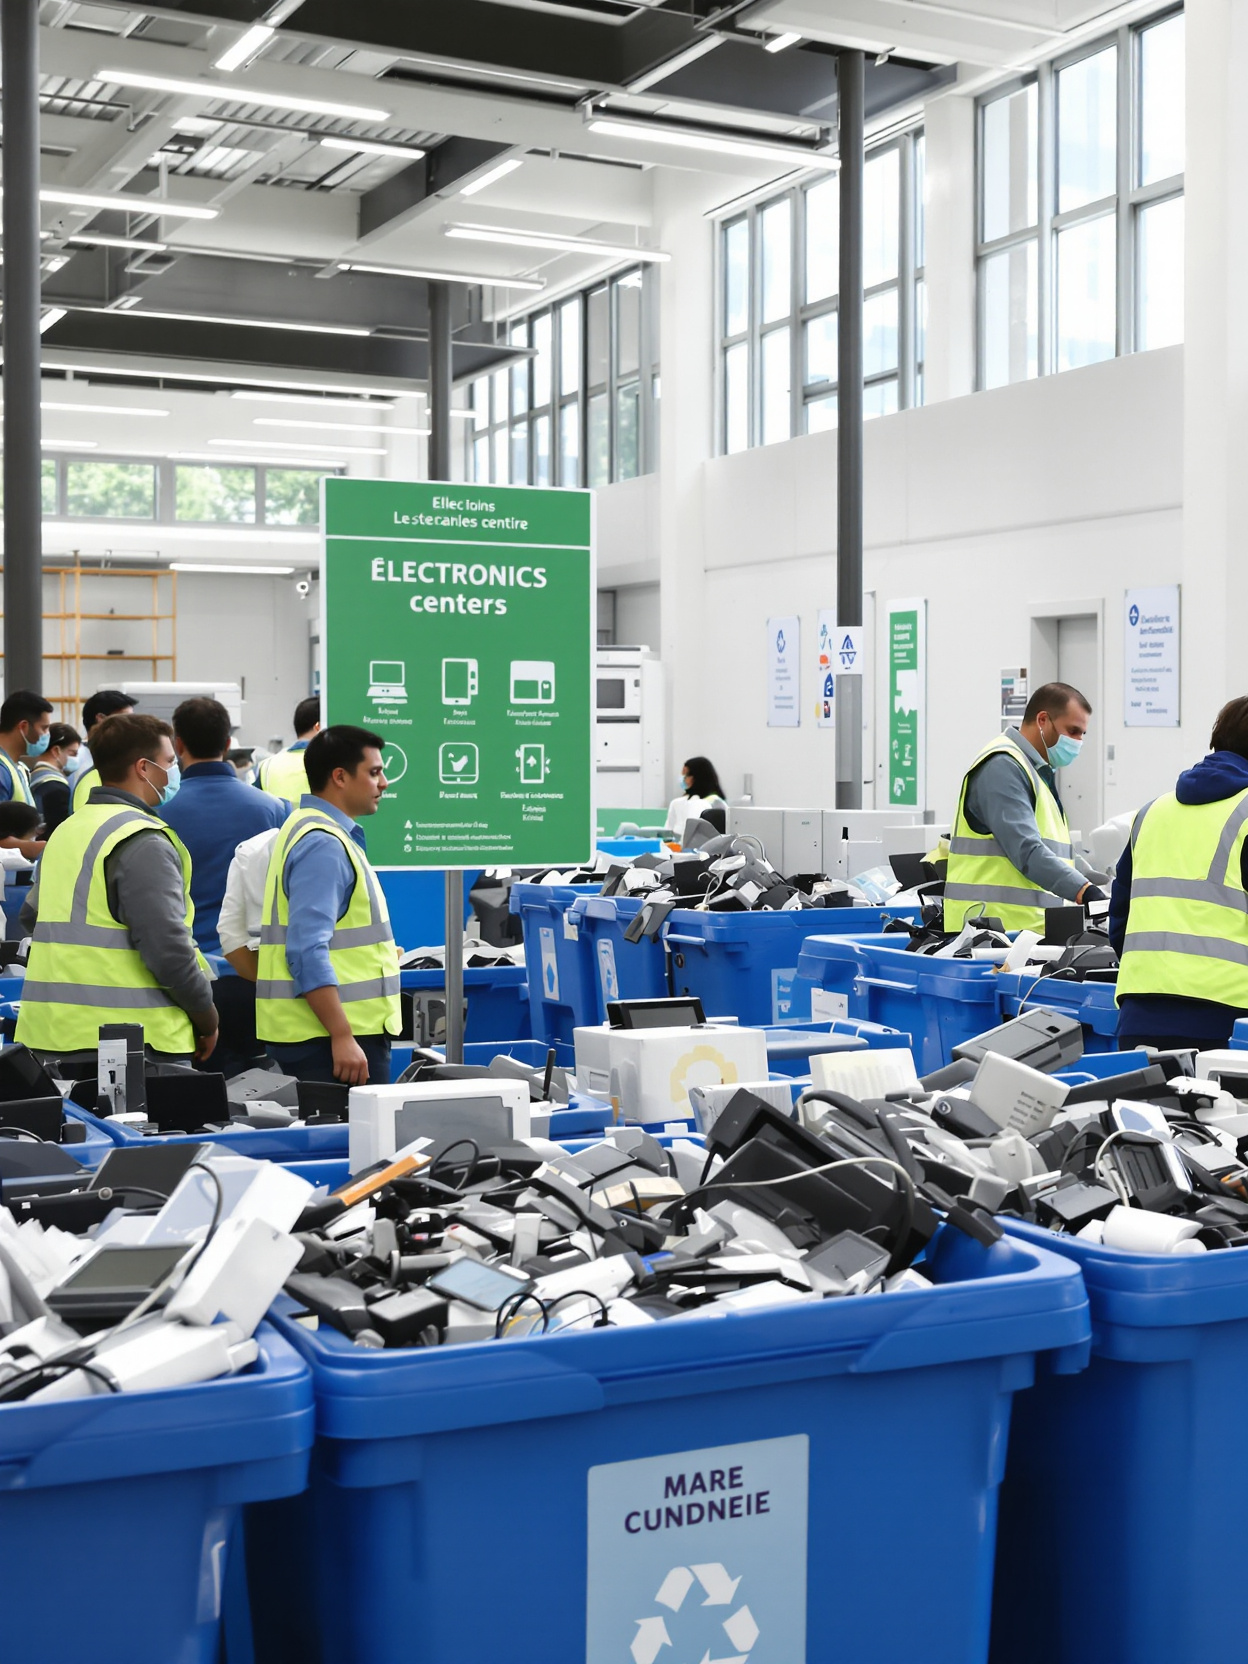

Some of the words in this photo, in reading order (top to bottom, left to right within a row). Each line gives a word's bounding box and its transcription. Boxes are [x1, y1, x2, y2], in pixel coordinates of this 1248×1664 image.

[410, 594, 507, 615] centers
[664, 1466, 743, 1499] MARE
[624, 1490, 770, 1534] CUNDNEIE
